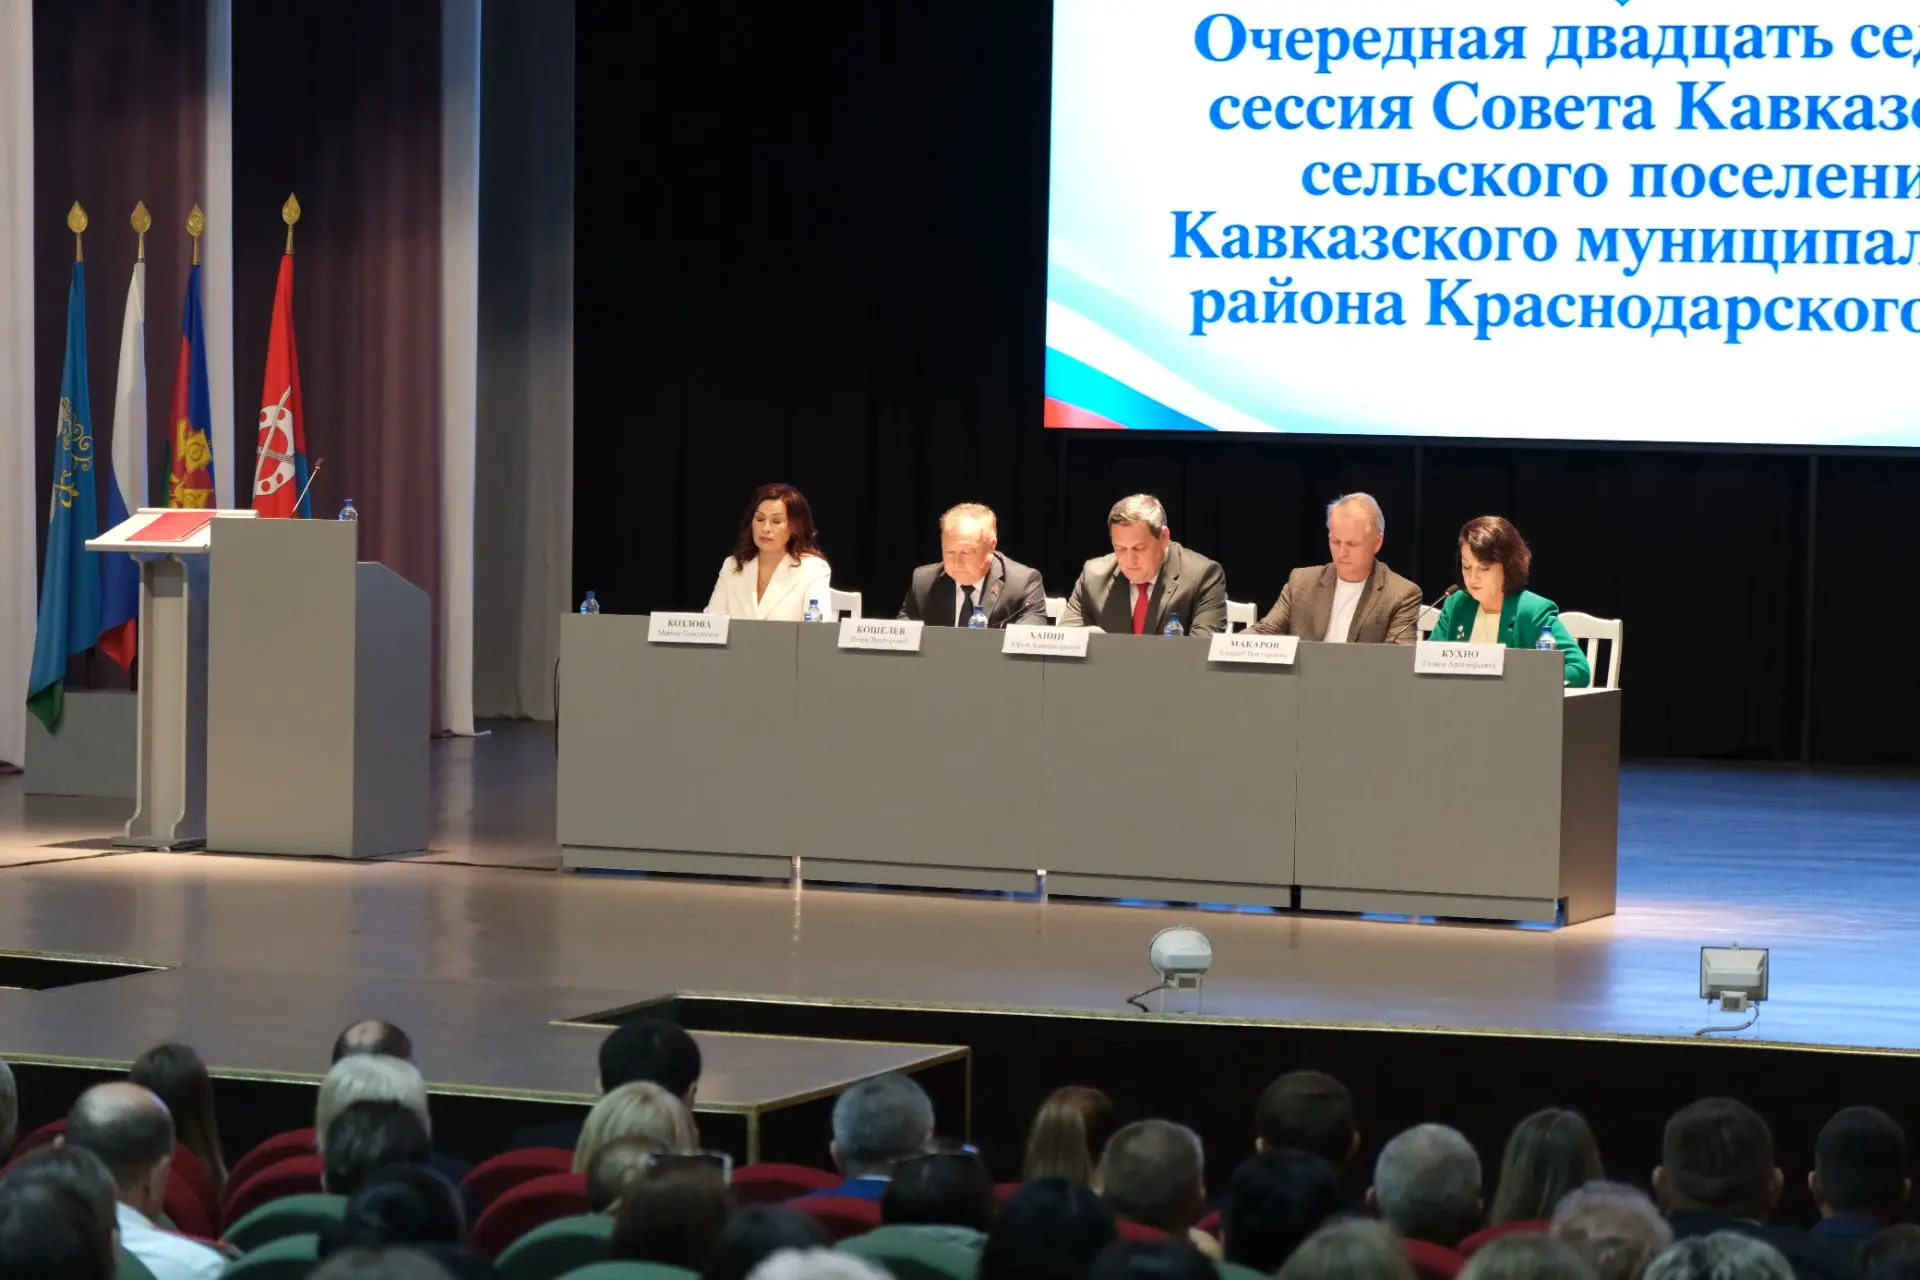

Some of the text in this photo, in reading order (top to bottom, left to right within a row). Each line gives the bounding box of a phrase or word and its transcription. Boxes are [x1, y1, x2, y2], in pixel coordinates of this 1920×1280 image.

[1195, 14, 1920, 74] Очередная двадцать се
[1209, 96, 1413, 130] сессия
[1433, 81, 1656, 130] Совета
[1302, 162, 1920, 199] сельского поселени
[1170, 211, 1920, 277] Кавказского муниципал
[1189, 276, 1406, 336] района
[667, 619, 712, 629] КОЗЛОВА
[856, 625, 906, 635] КОШЕЛЕВ
[1230, 640, 1281, 649] МАКАРОВ
